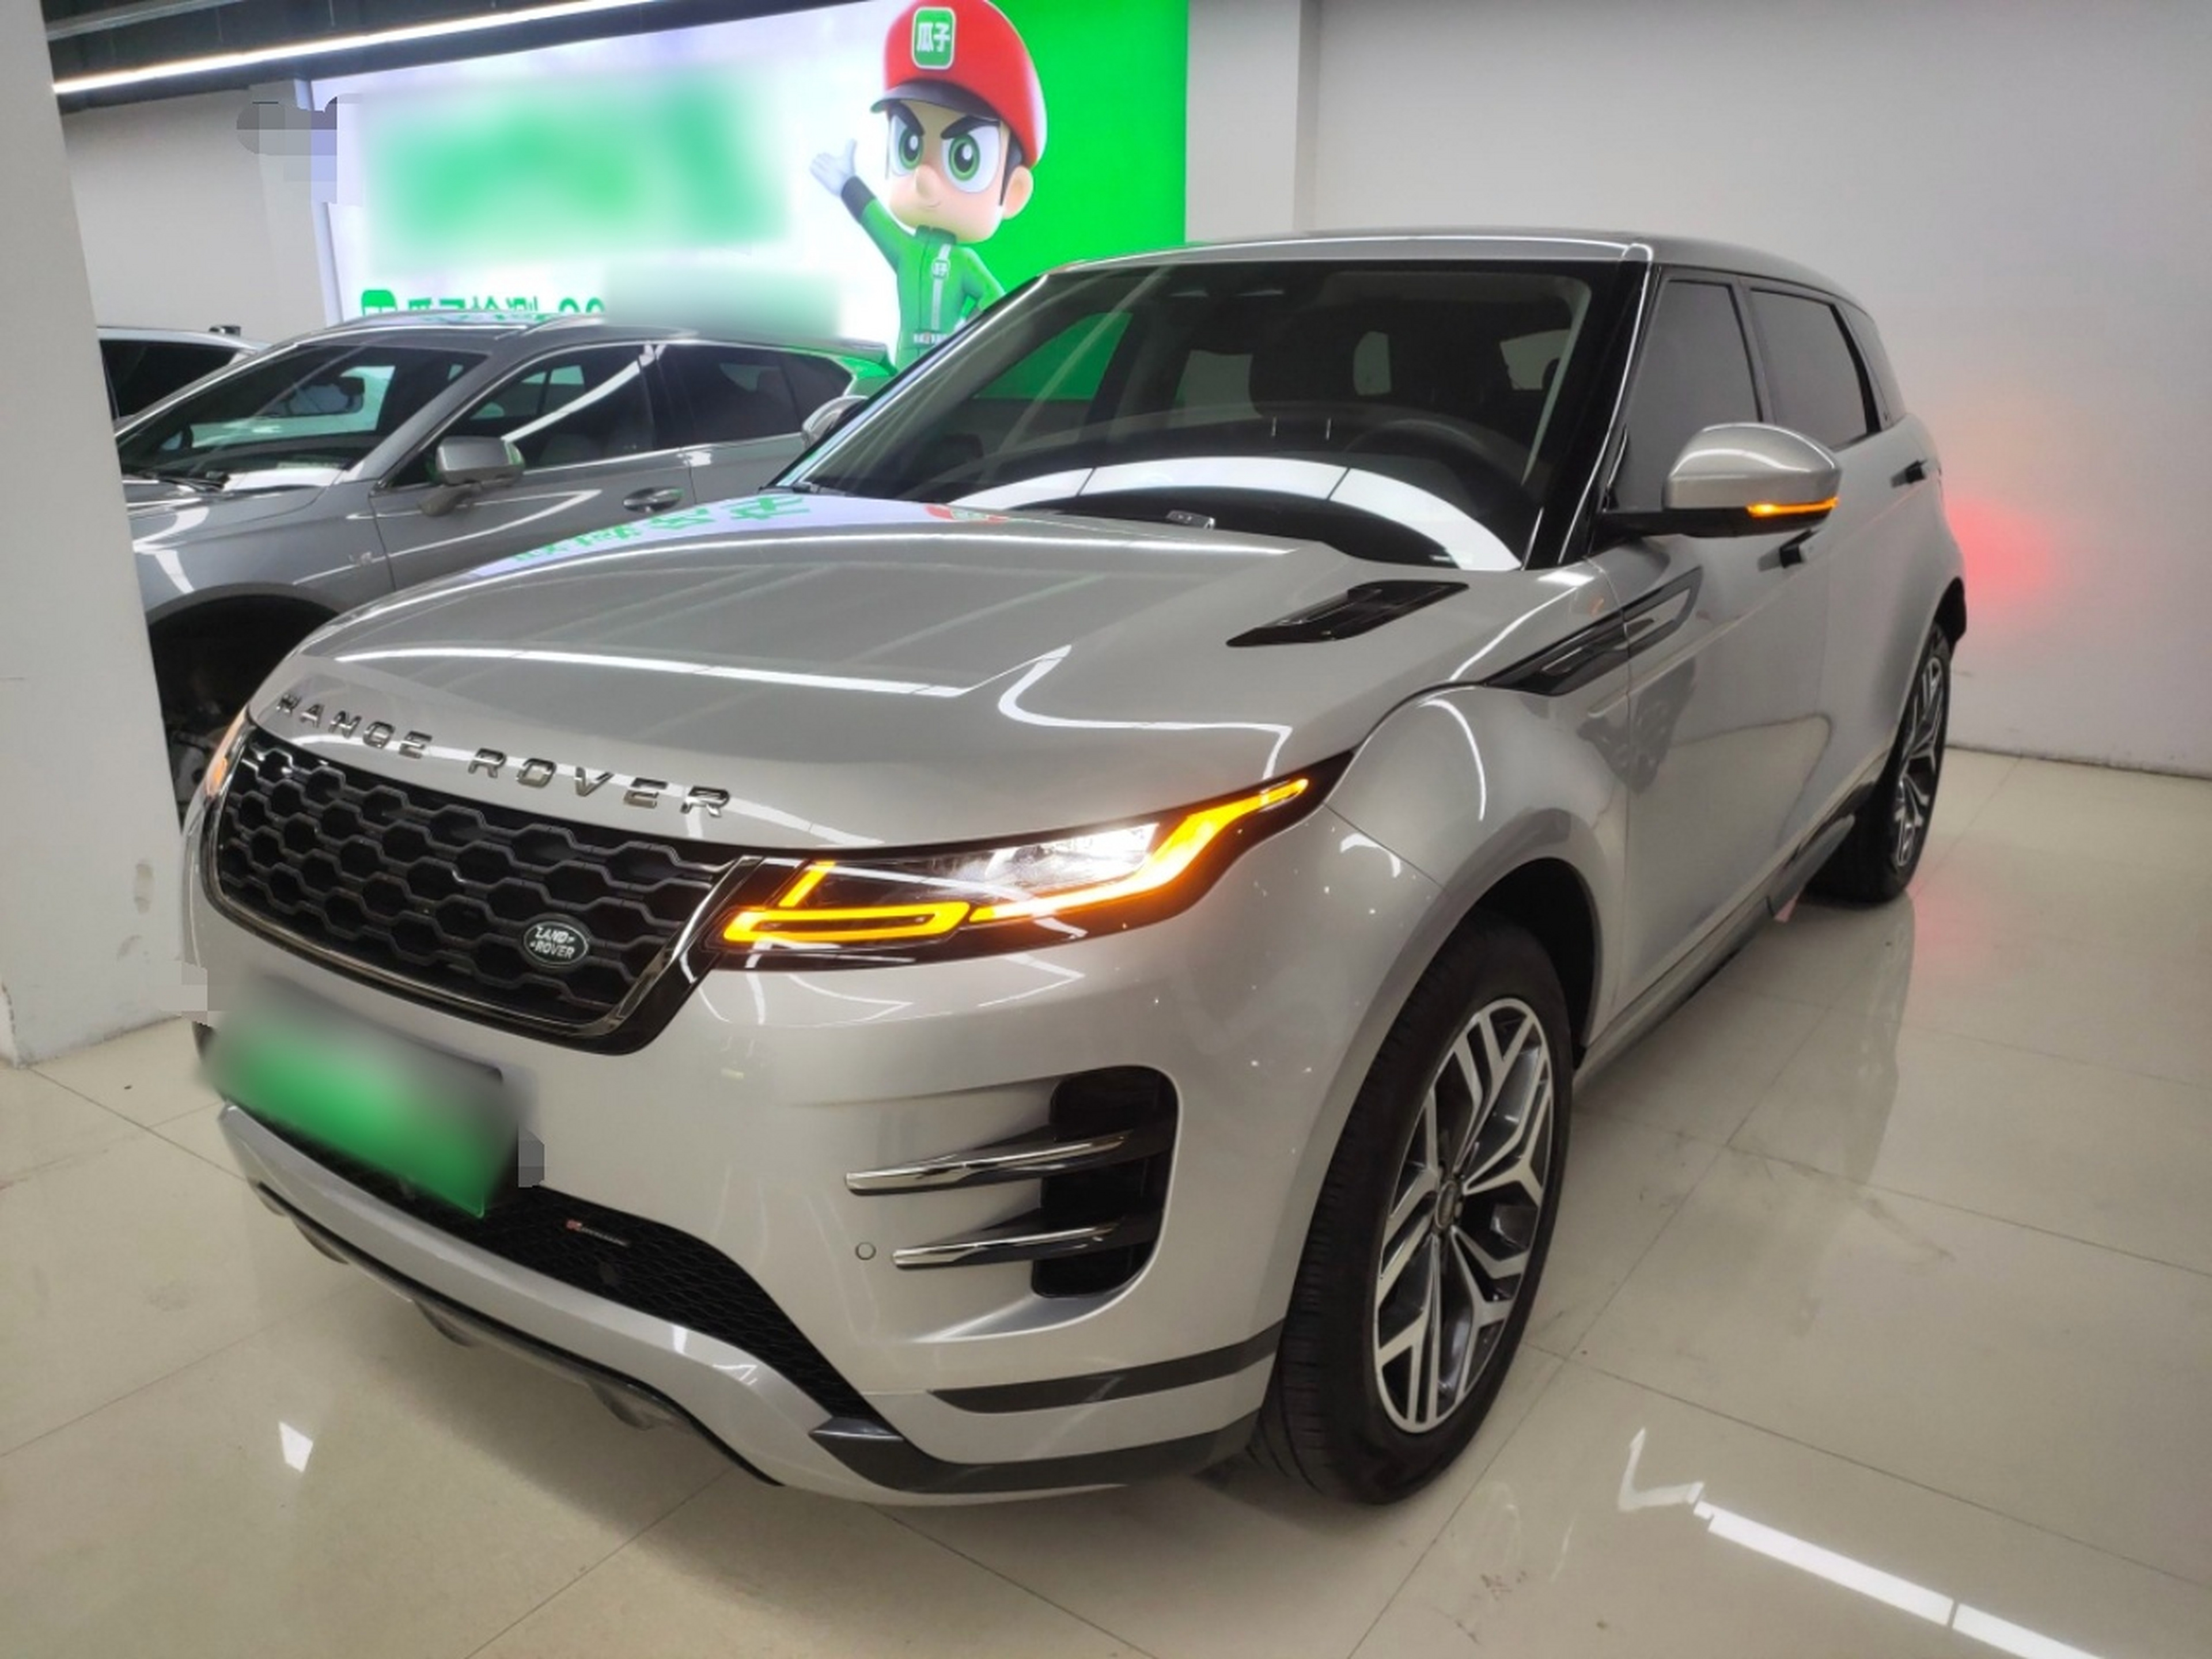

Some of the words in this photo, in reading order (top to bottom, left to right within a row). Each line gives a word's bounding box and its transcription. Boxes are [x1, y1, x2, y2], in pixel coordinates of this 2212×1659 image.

[916, 22, 950, 52] 瓜子
[275, 692, 433, 759] RANGE
[468, 747, 730, 818] ROVER
